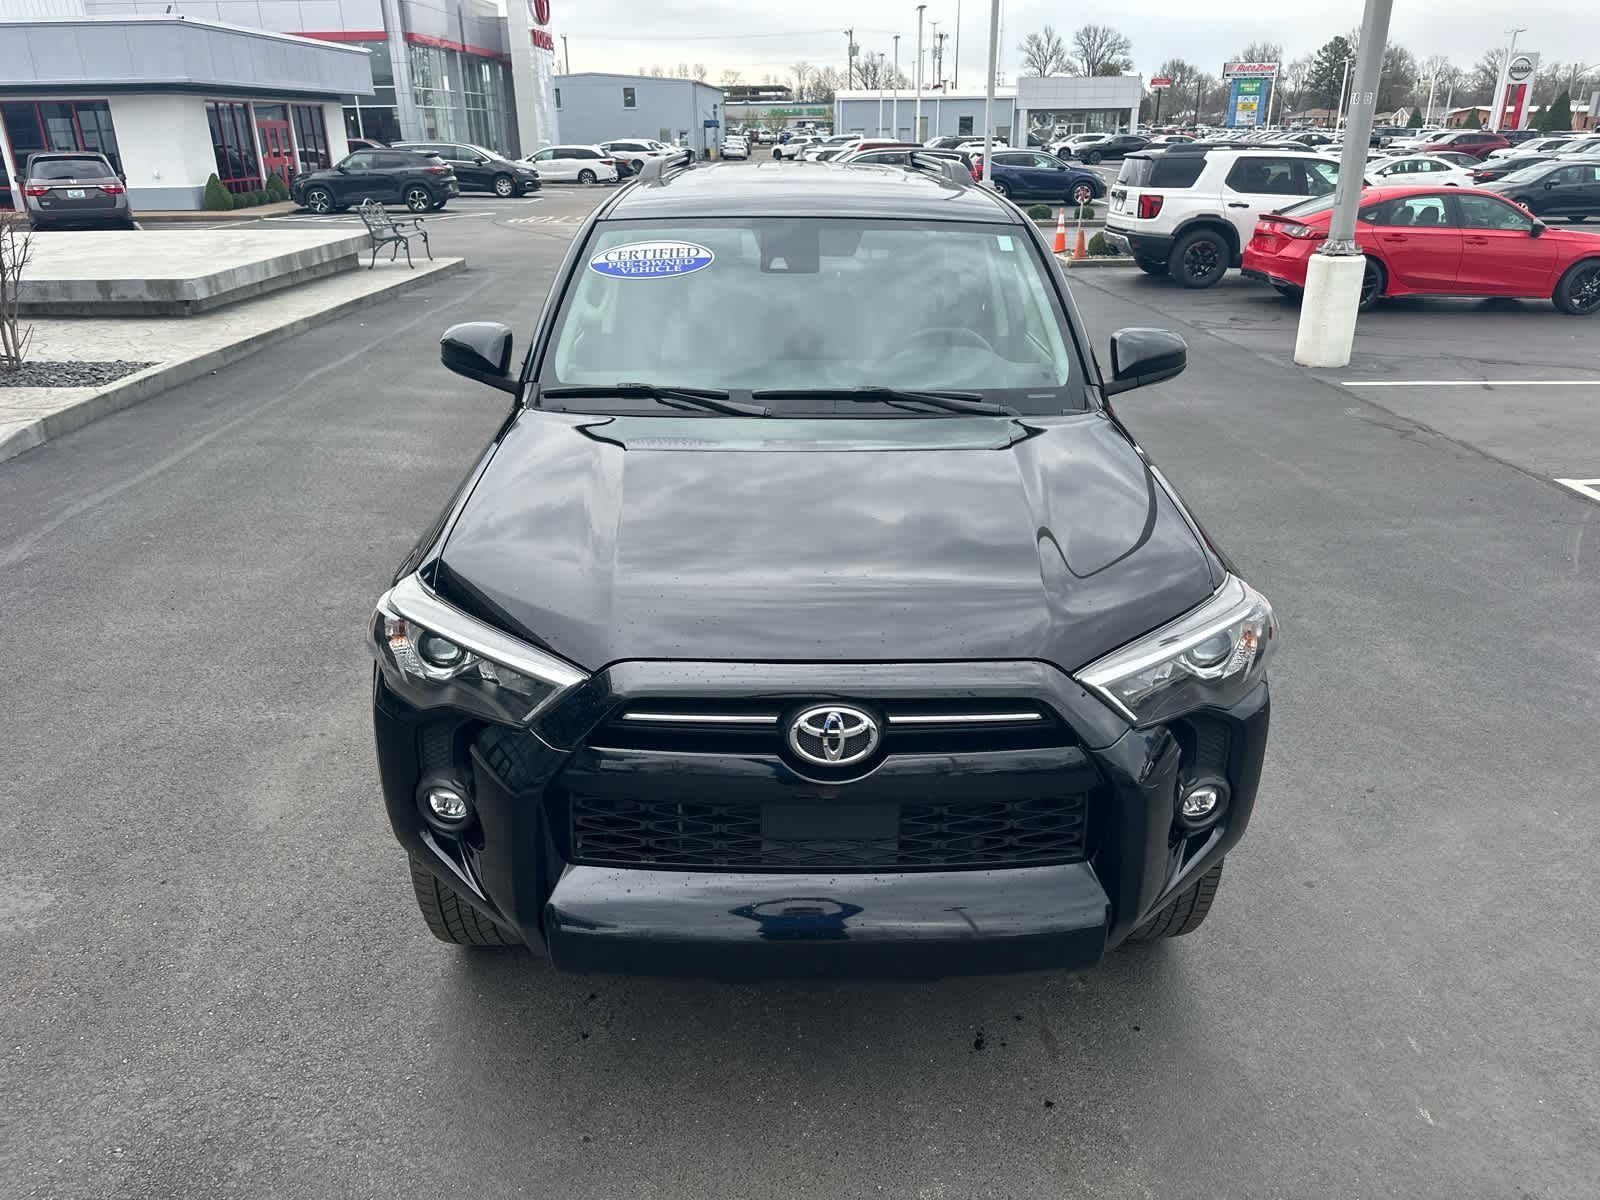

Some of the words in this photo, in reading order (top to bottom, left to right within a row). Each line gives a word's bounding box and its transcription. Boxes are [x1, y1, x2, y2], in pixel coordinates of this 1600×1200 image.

[1237, 63, 1276, 72] AutoZone
[604, 247, 700, 262] CERTIFIED
[607, 258, 695, 269] PRE-OWNED
[618, 264, 682, 274] VEHICLE
